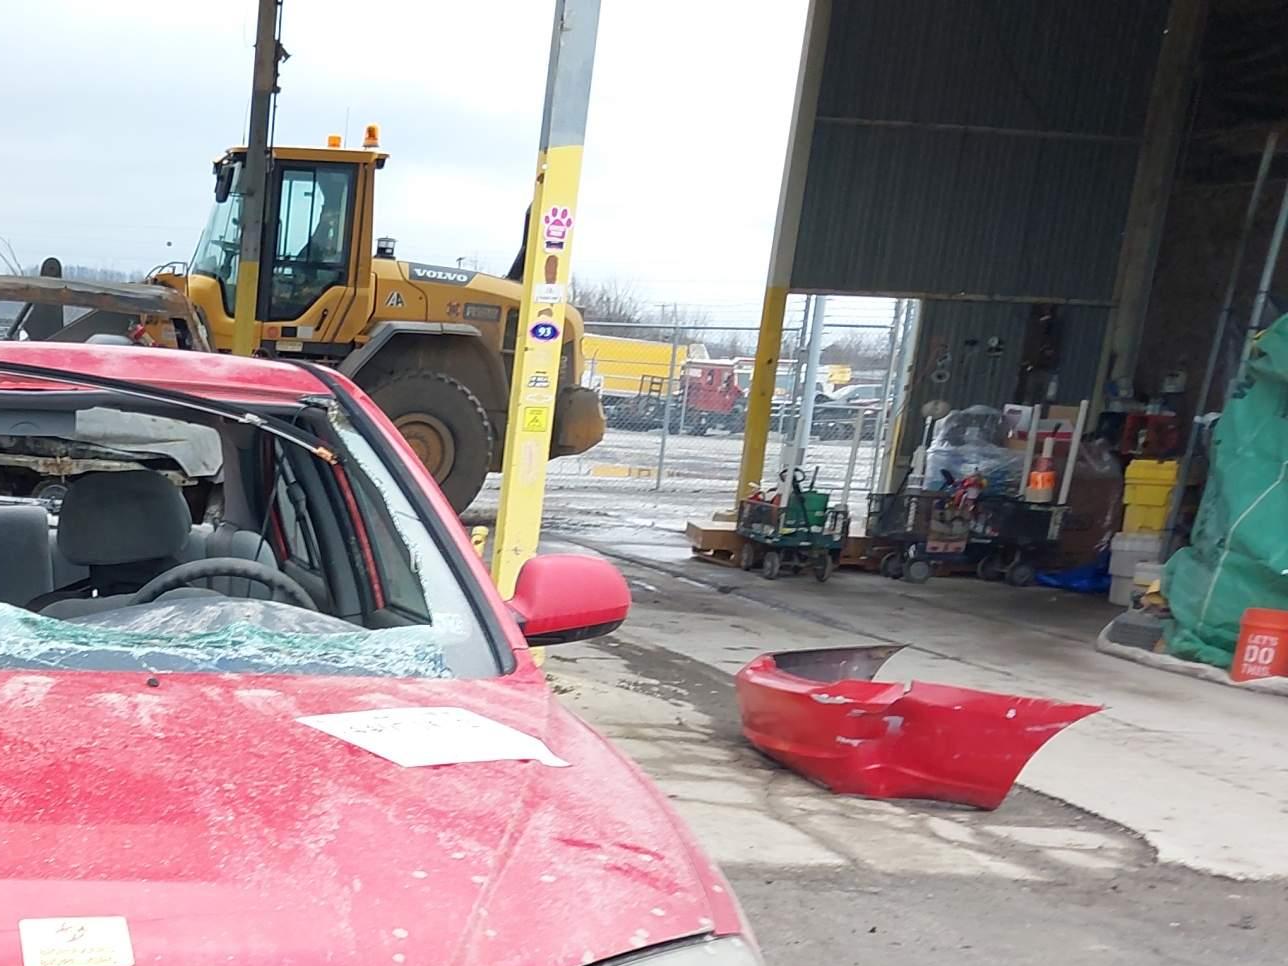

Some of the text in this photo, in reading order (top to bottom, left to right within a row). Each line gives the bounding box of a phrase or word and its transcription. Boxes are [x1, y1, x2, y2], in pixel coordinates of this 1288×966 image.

[414, 268, 468, 282] VOLVO
[537, 326, 552, 337] 93
[1244, 645, 1276, 664] DO
